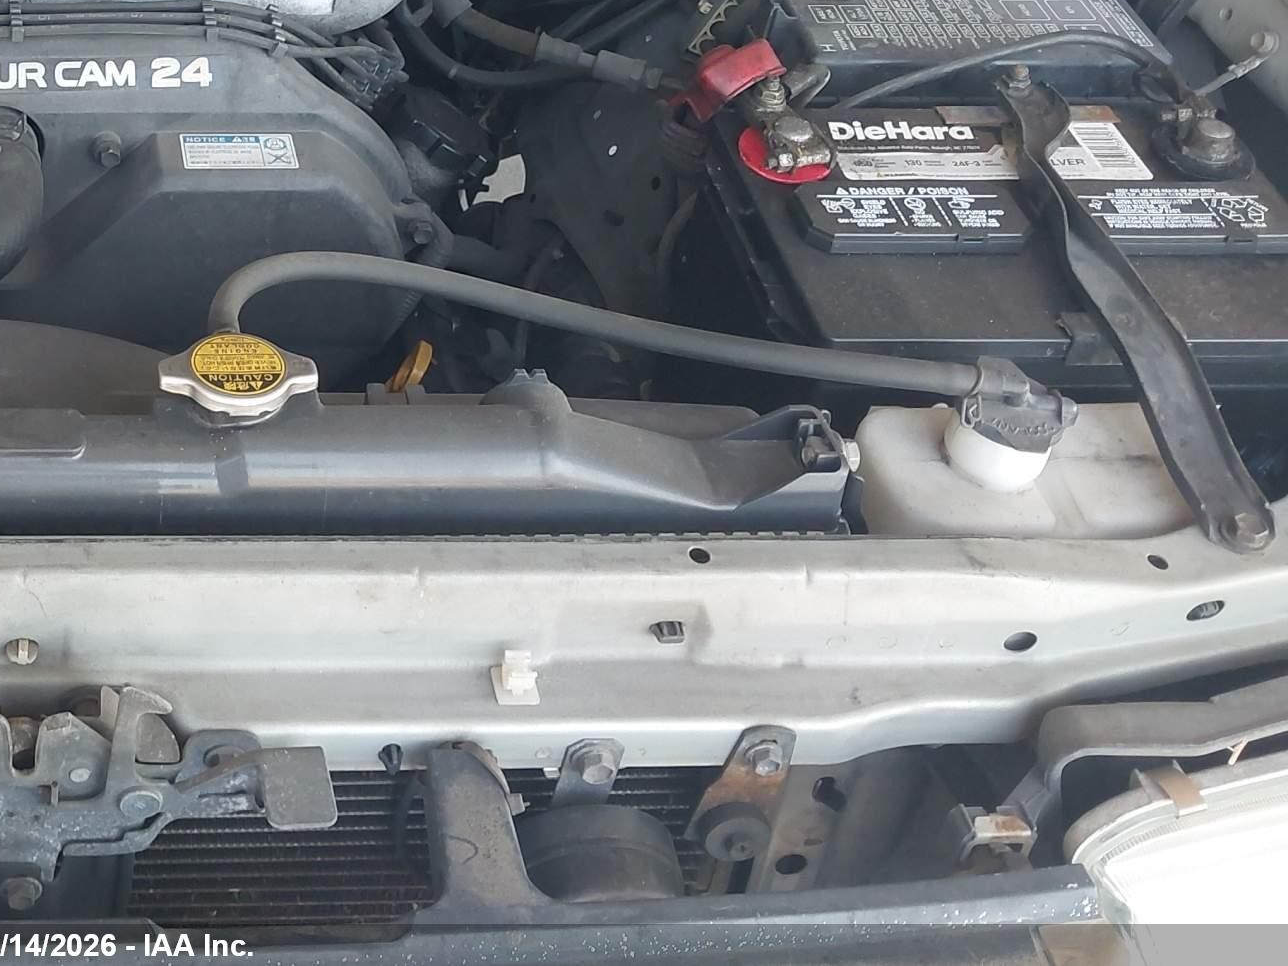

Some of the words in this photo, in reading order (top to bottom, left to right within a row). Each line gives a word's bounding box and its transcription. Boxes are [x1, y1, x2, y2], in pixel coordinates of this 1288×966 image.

[54, 59, 137, 89] CAM
[150, 56, 213, 88] 24
[848, 186, 906, 196] DANGER
[918, 186, 970, 196] POISON
[208, 374, 273, 382] CAUTION
